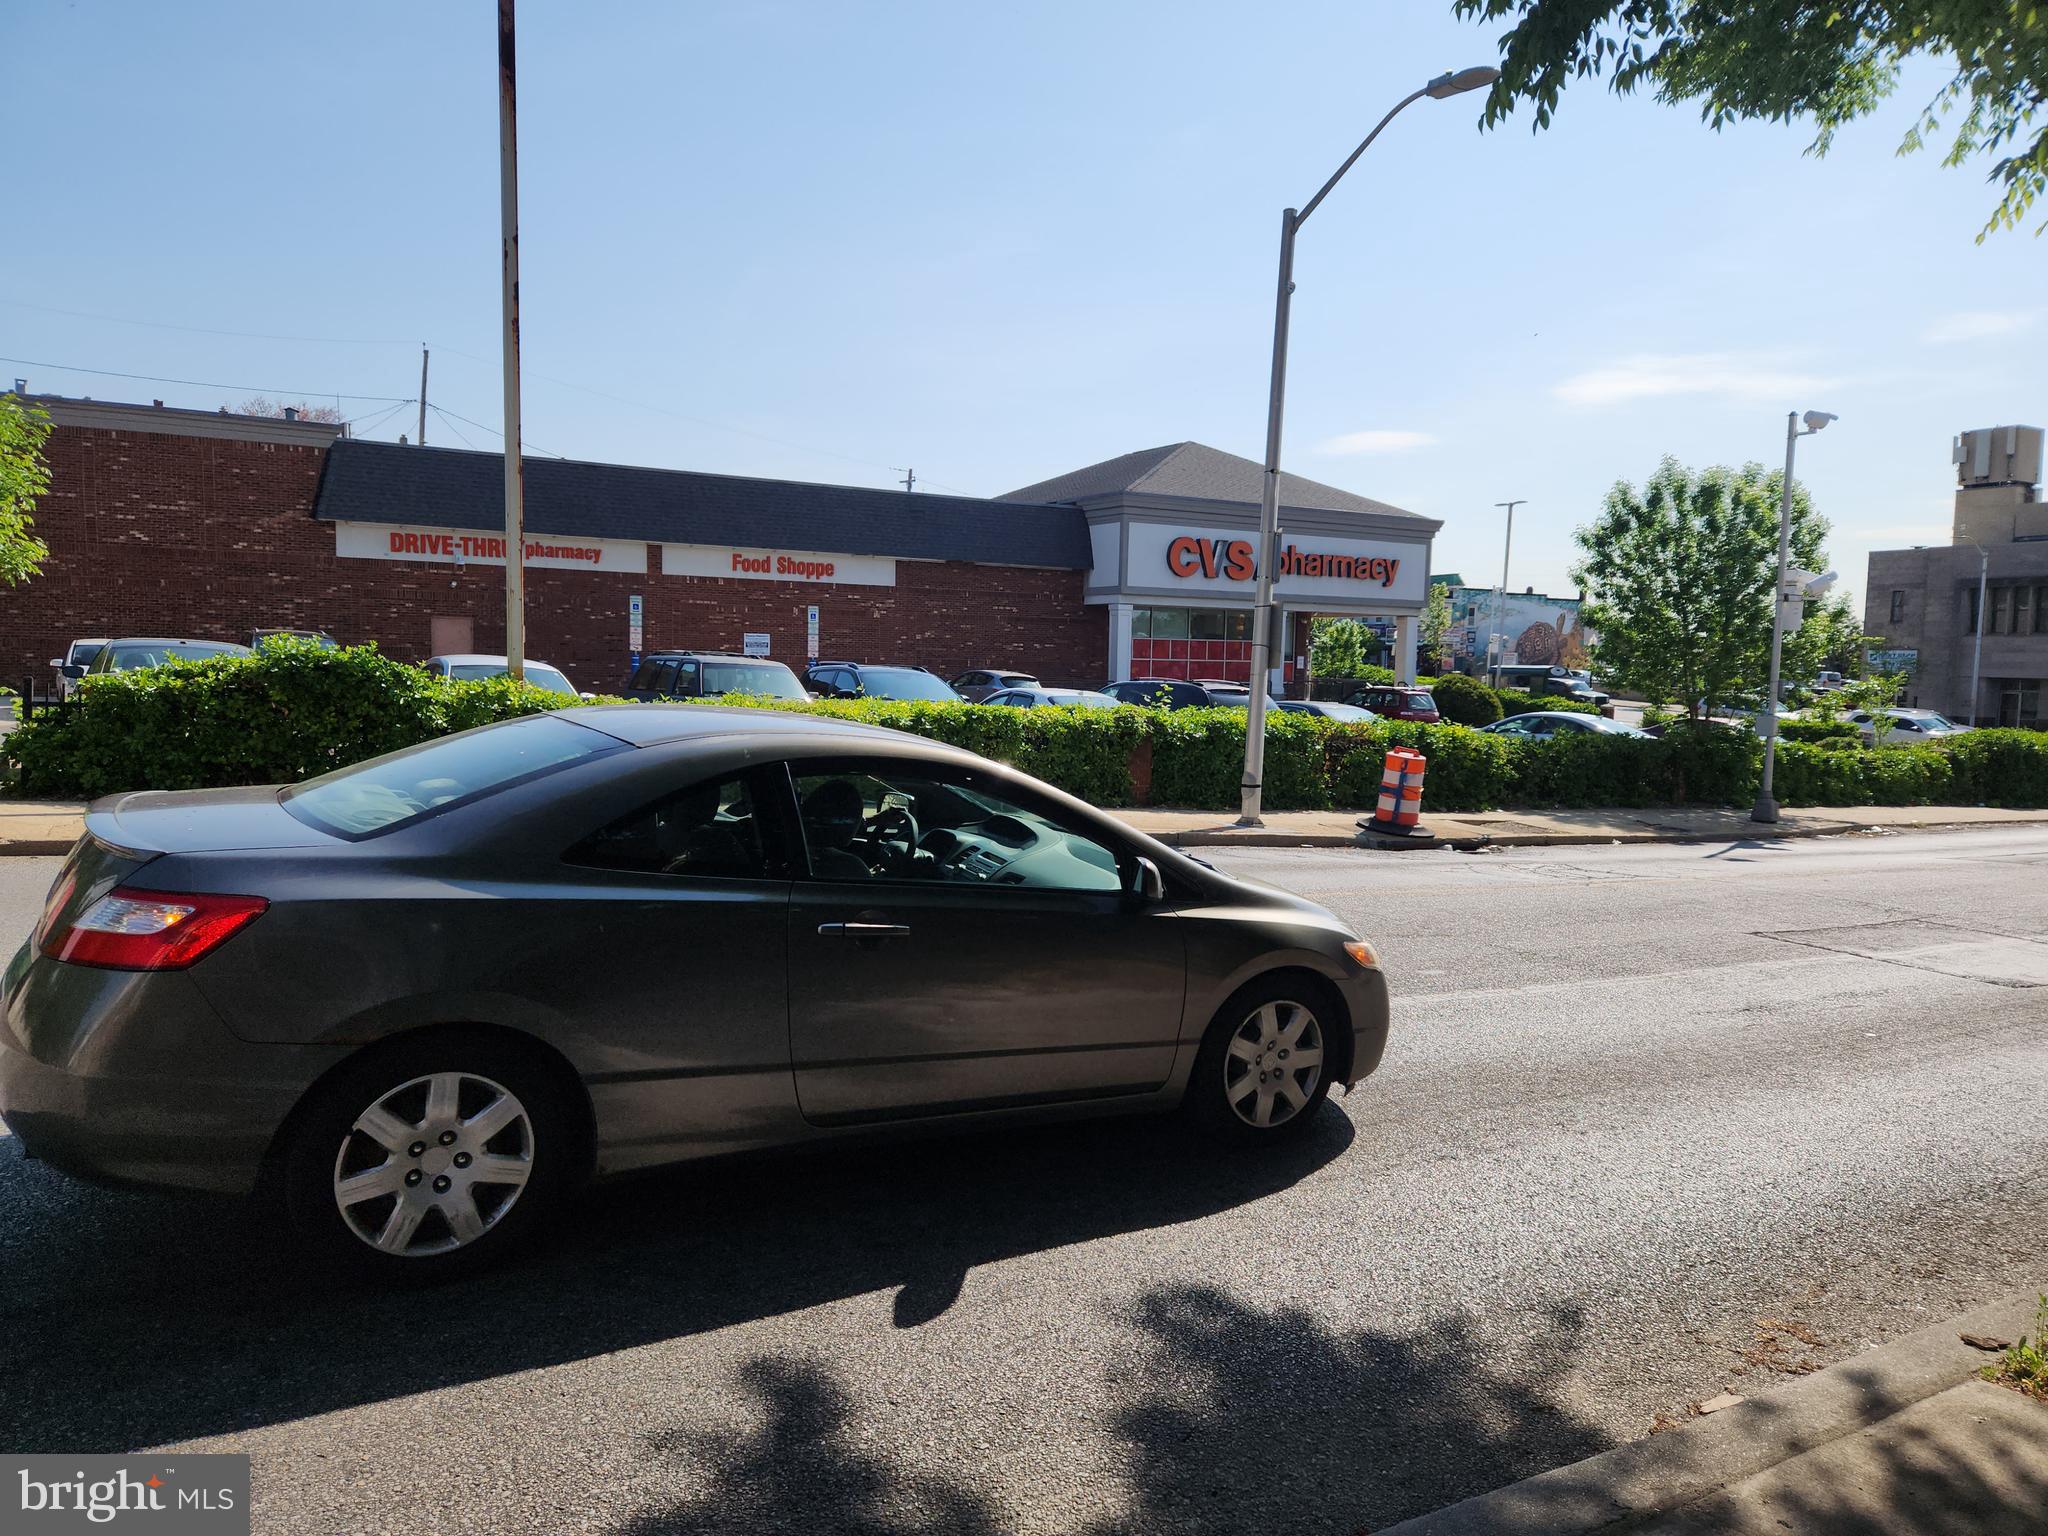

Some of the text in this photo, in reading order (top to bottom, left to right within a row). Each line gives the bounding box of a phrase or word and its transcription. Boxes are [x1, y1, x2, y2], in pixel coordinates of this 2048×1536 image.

[525, 541, 602, 564] pharmacy
[1167, 536, 1254, 581] CVS
[732, 553, 834, 579] Food Shoppe
